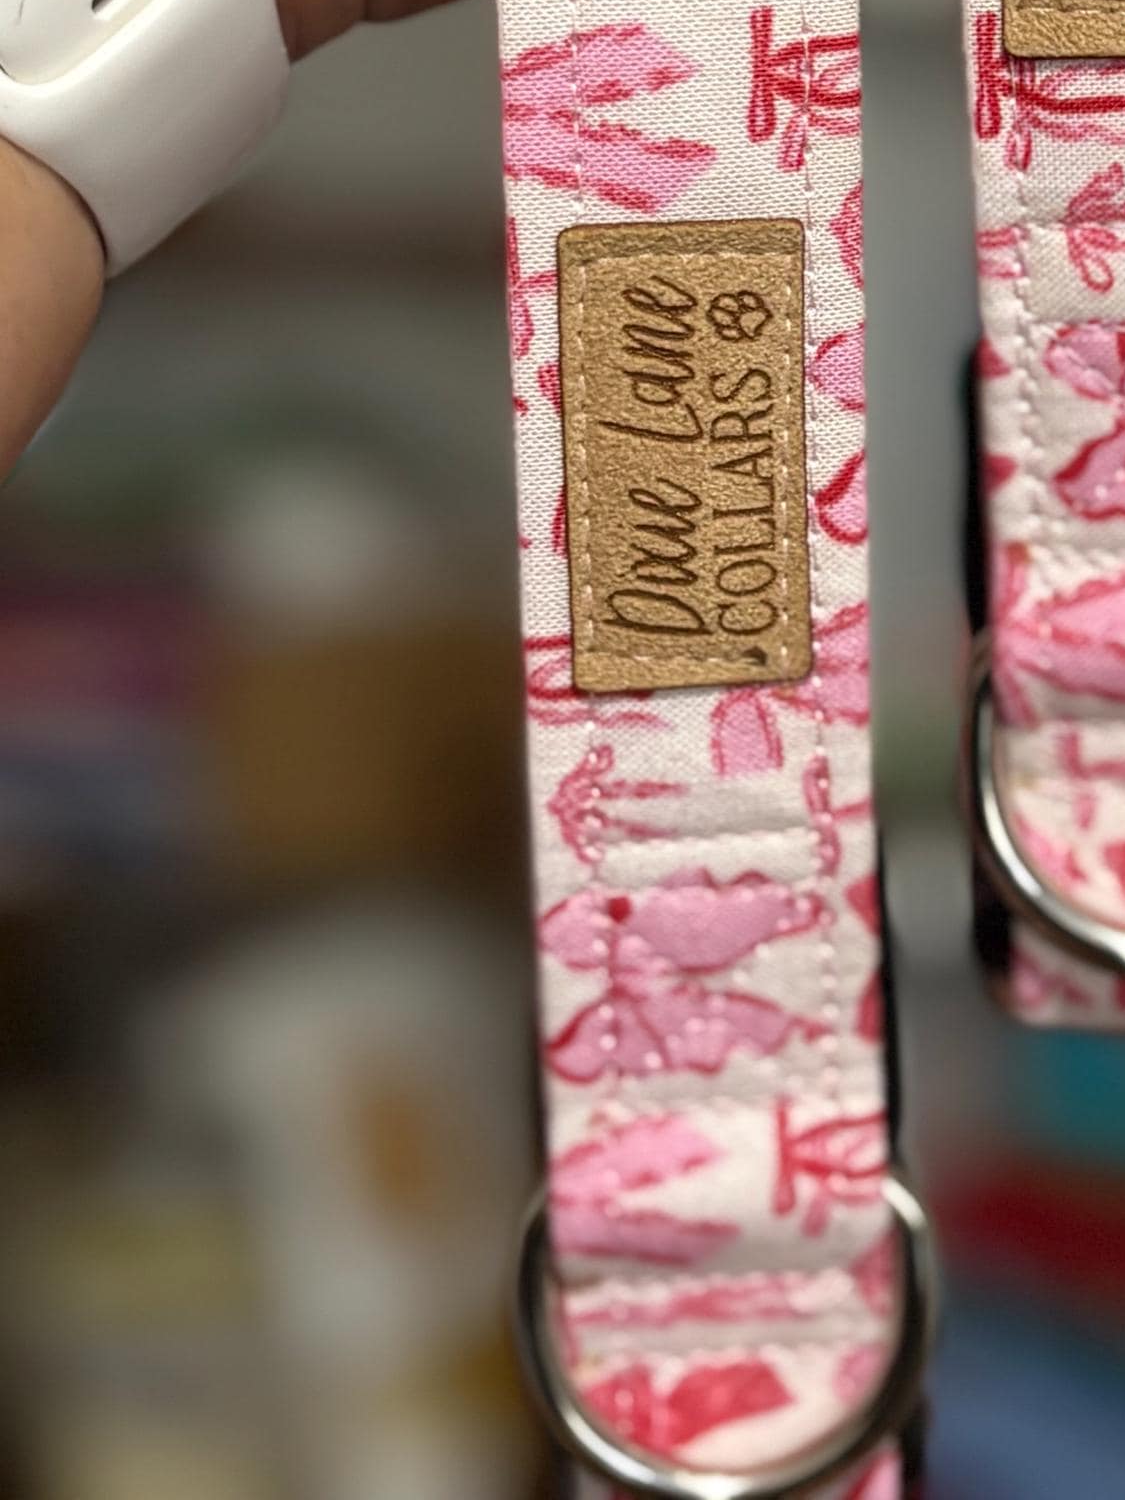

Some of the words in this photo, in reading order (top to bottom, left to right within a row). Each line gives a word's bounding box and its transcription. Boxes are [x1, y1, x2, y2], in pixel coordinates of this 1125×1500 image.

[600, 275, 702, 444] Lane
[601, 476, 716, 636] Dixie
[709, 368, 779, 637] COLLARS
